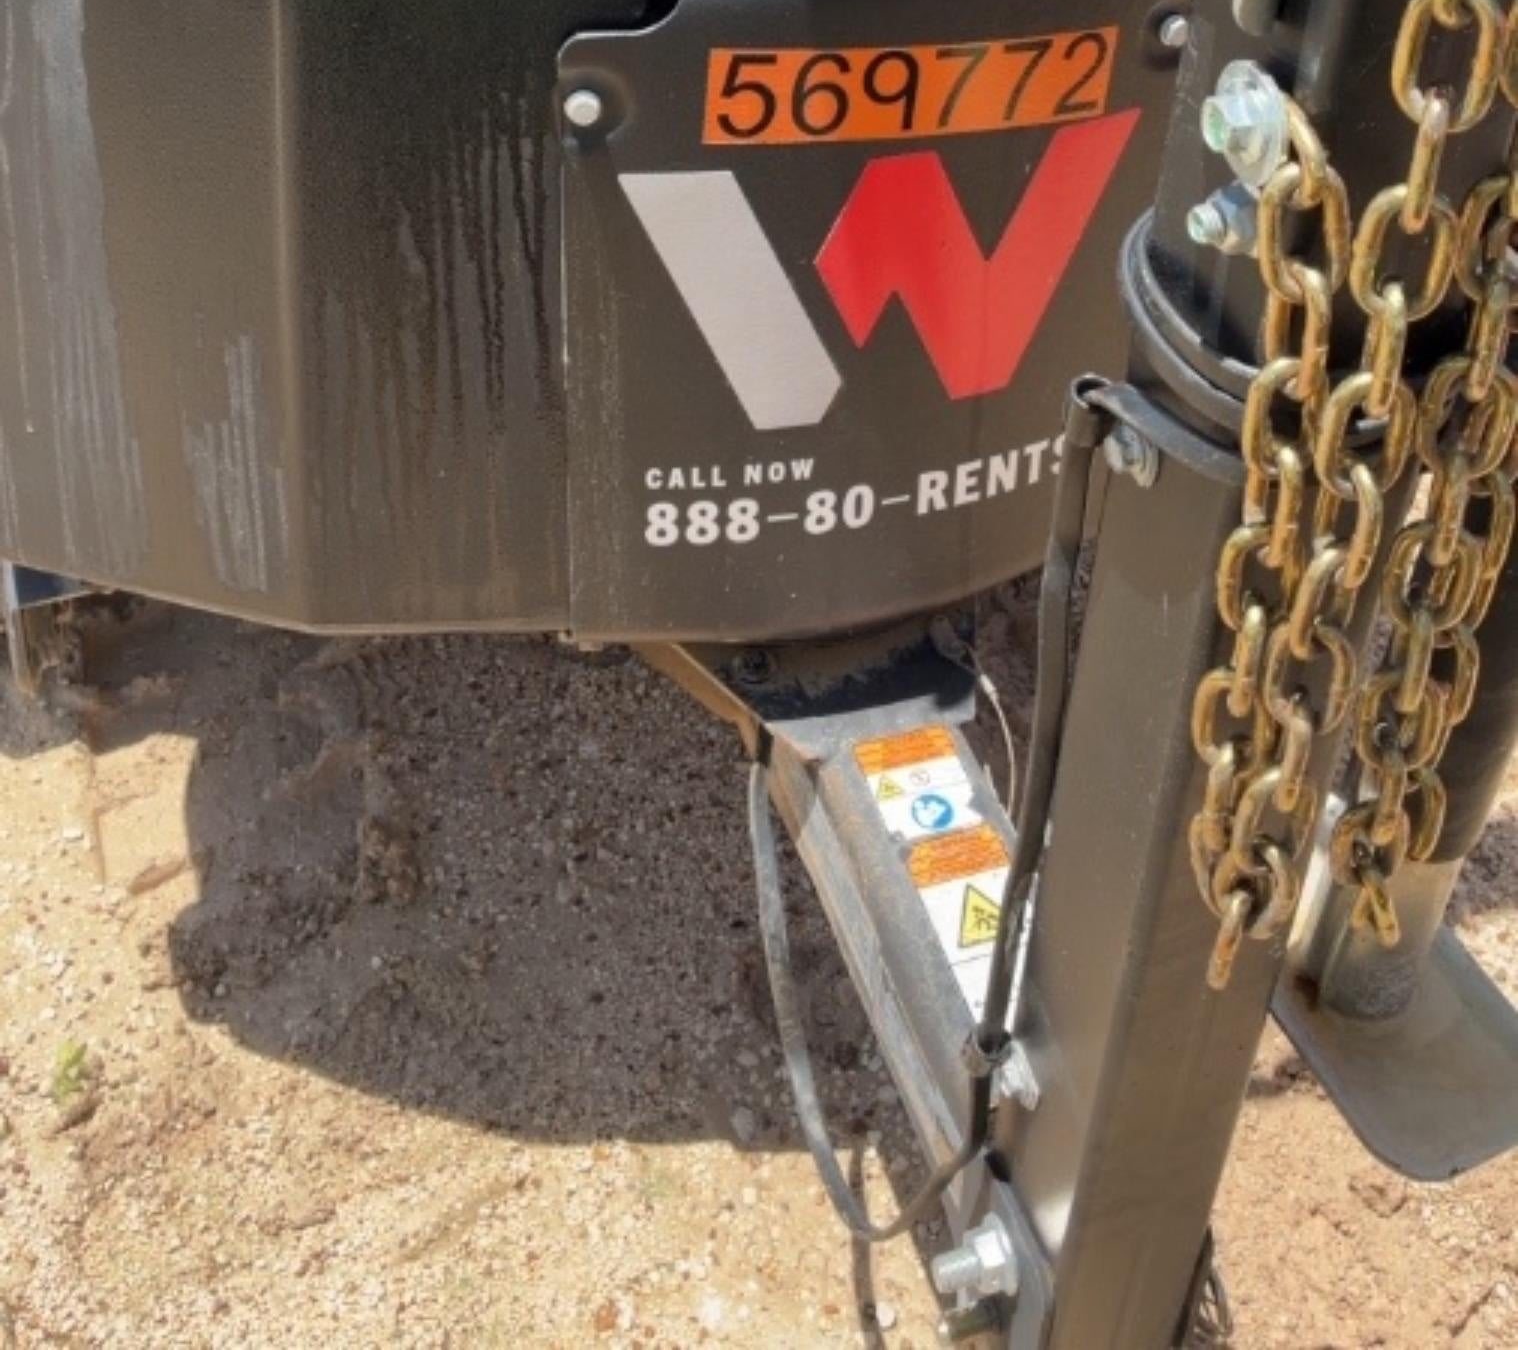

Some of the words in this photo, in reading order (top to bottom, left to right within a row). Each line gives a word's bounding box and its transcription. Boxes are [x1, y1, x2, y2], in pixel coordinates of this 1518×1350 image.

[716, 32, 1108, 138] 569772
[645, 466, 727, 490] CALL
[744, 458, 815, 485] NOW
